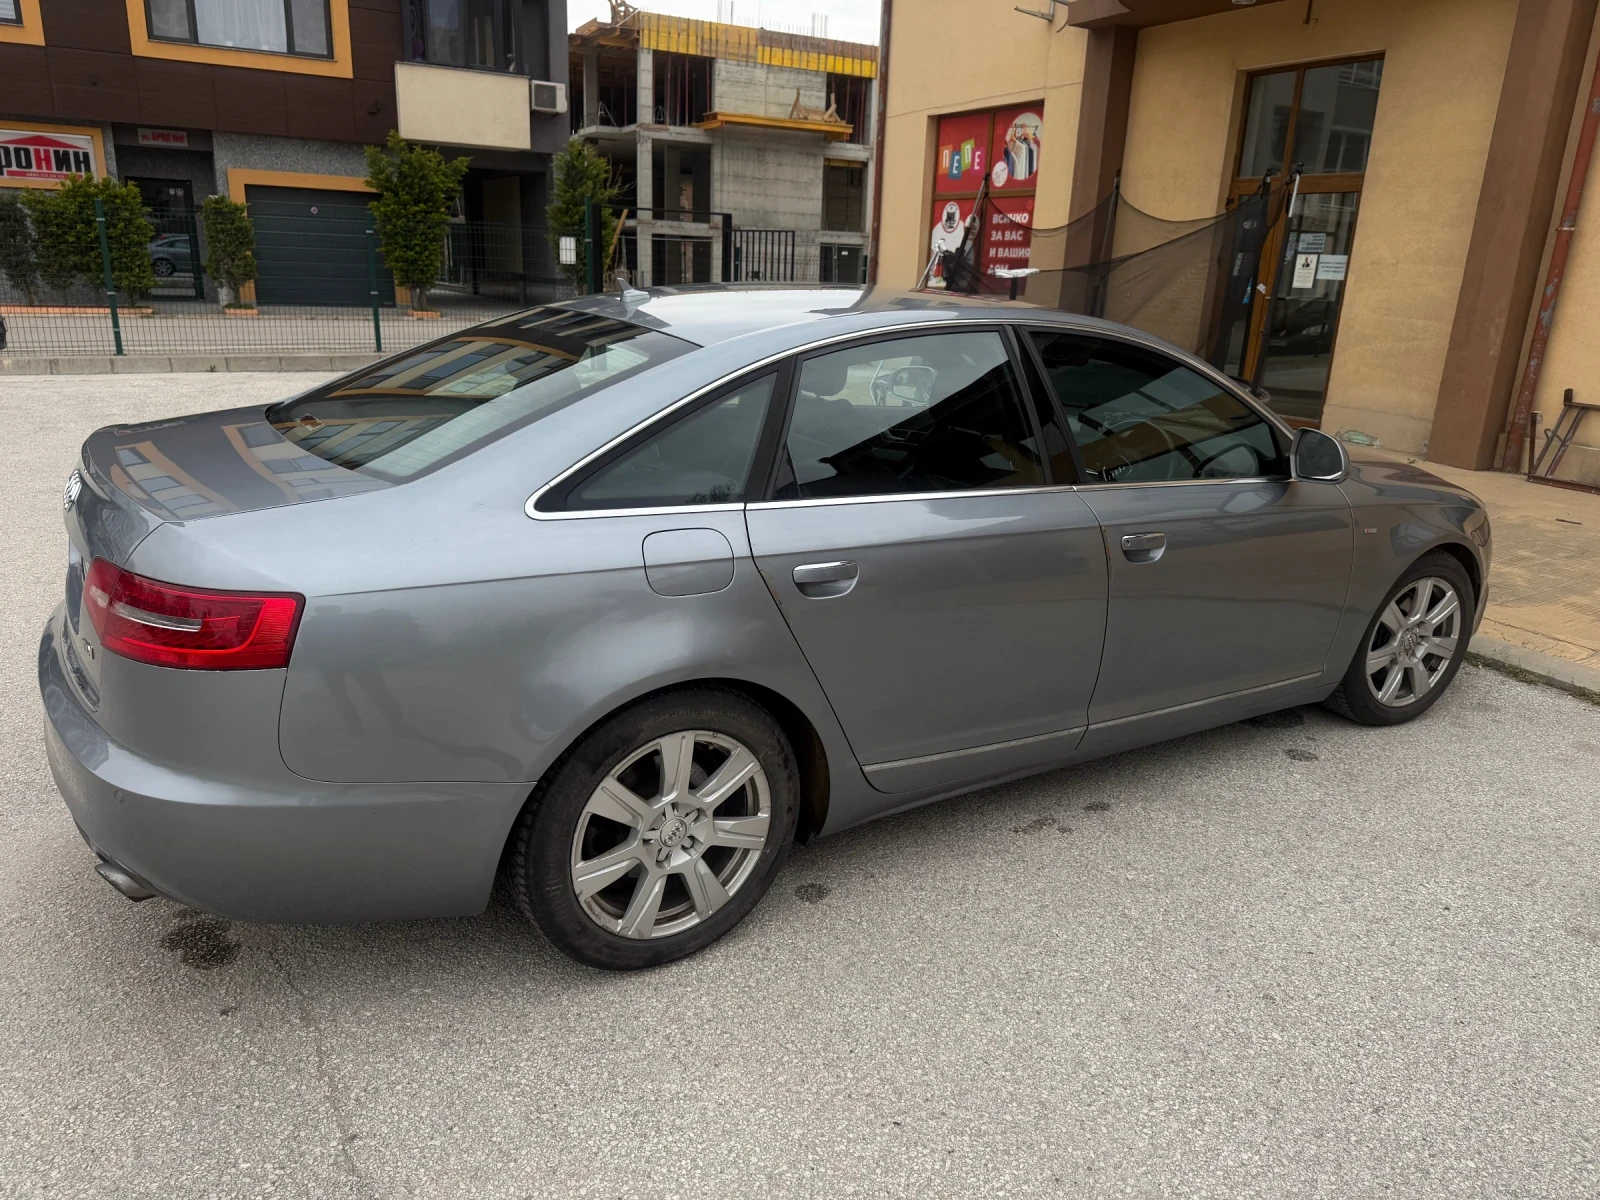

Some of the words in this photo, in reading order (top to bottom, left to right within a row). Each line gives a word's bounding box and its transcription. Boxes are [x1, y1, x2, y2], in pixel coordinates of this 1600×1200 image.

[942, 144, 982, 174] ПЕПЕ
[992, 213, 1029, 224] ВСИЧКО
[990, 230, 1003, 241] ЗА
[1004, 230, 1024, 241] ВАС
[989, 247, 997, 258] И
[997, 247, 1031, 258] ВАШИЯ
